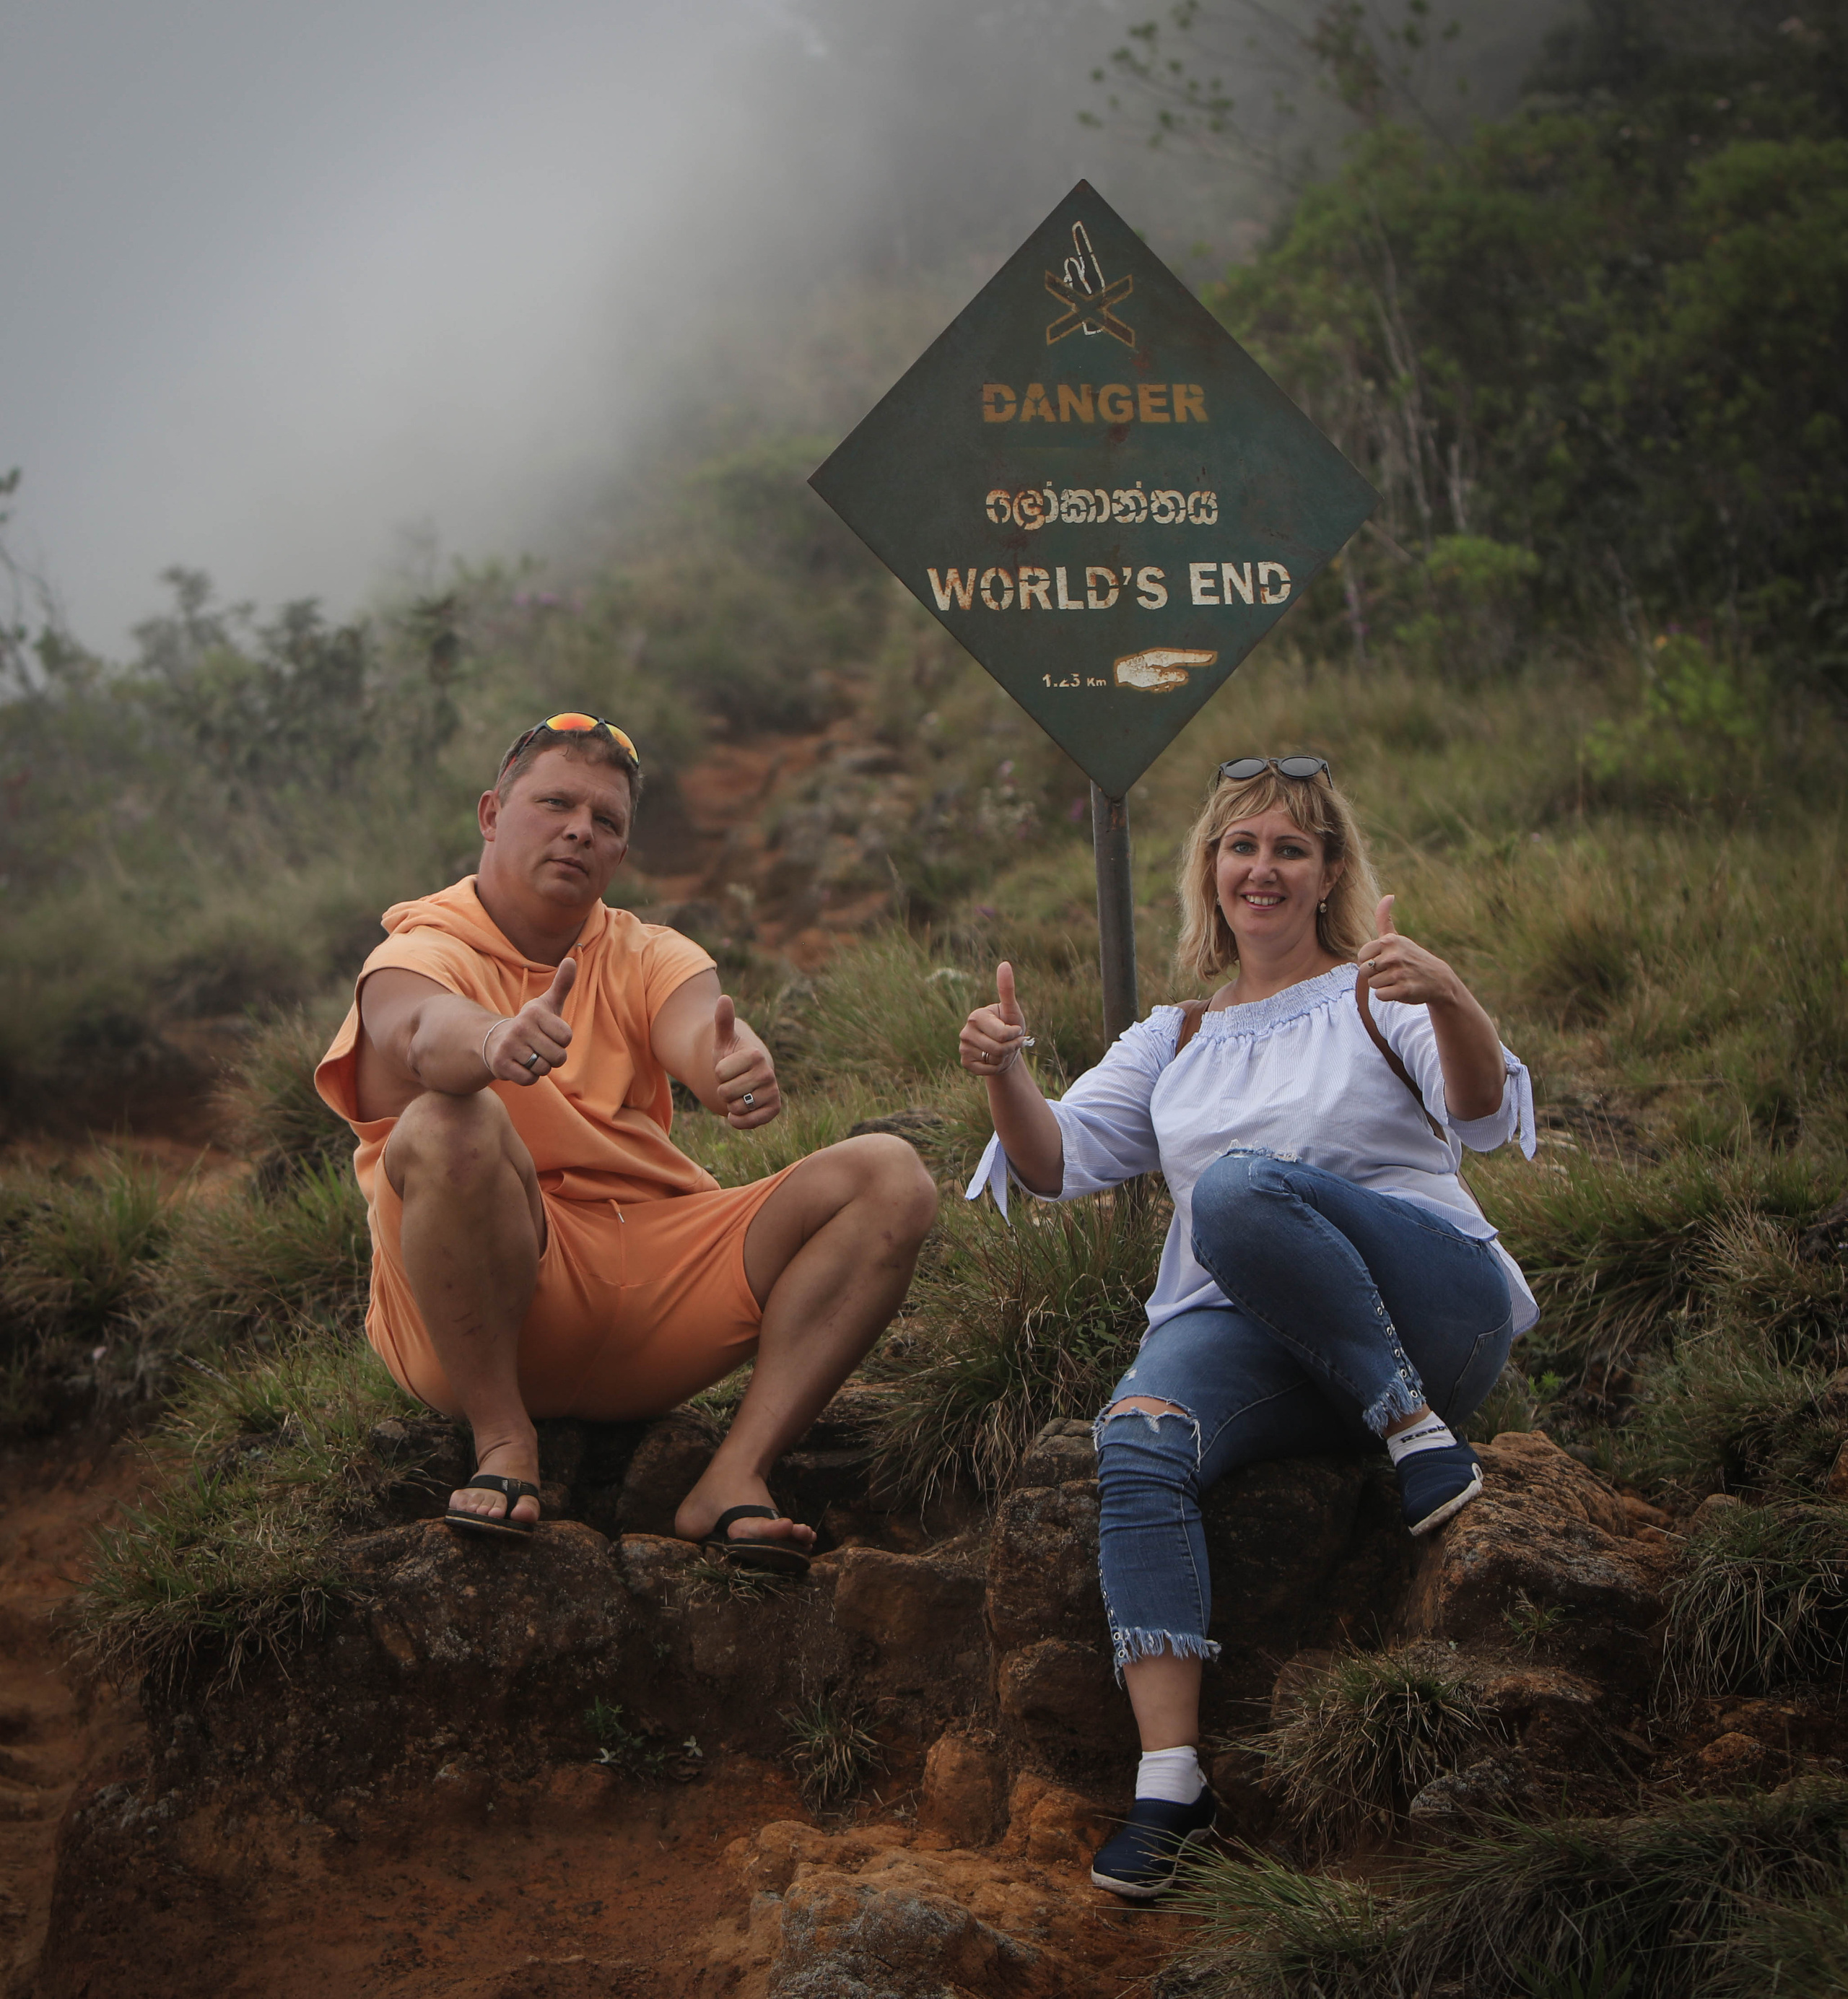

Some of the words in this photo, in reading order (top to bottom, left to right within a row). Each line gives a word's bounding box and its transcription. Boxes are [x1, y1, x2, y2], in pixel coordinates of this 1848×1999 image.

[982, 383, 1209, 423] DANGER
[927, 566, 1169, 611] WORLD'S
[1189, 561, 1291, 606] END
[1086, 677, 1107, 687] Km
